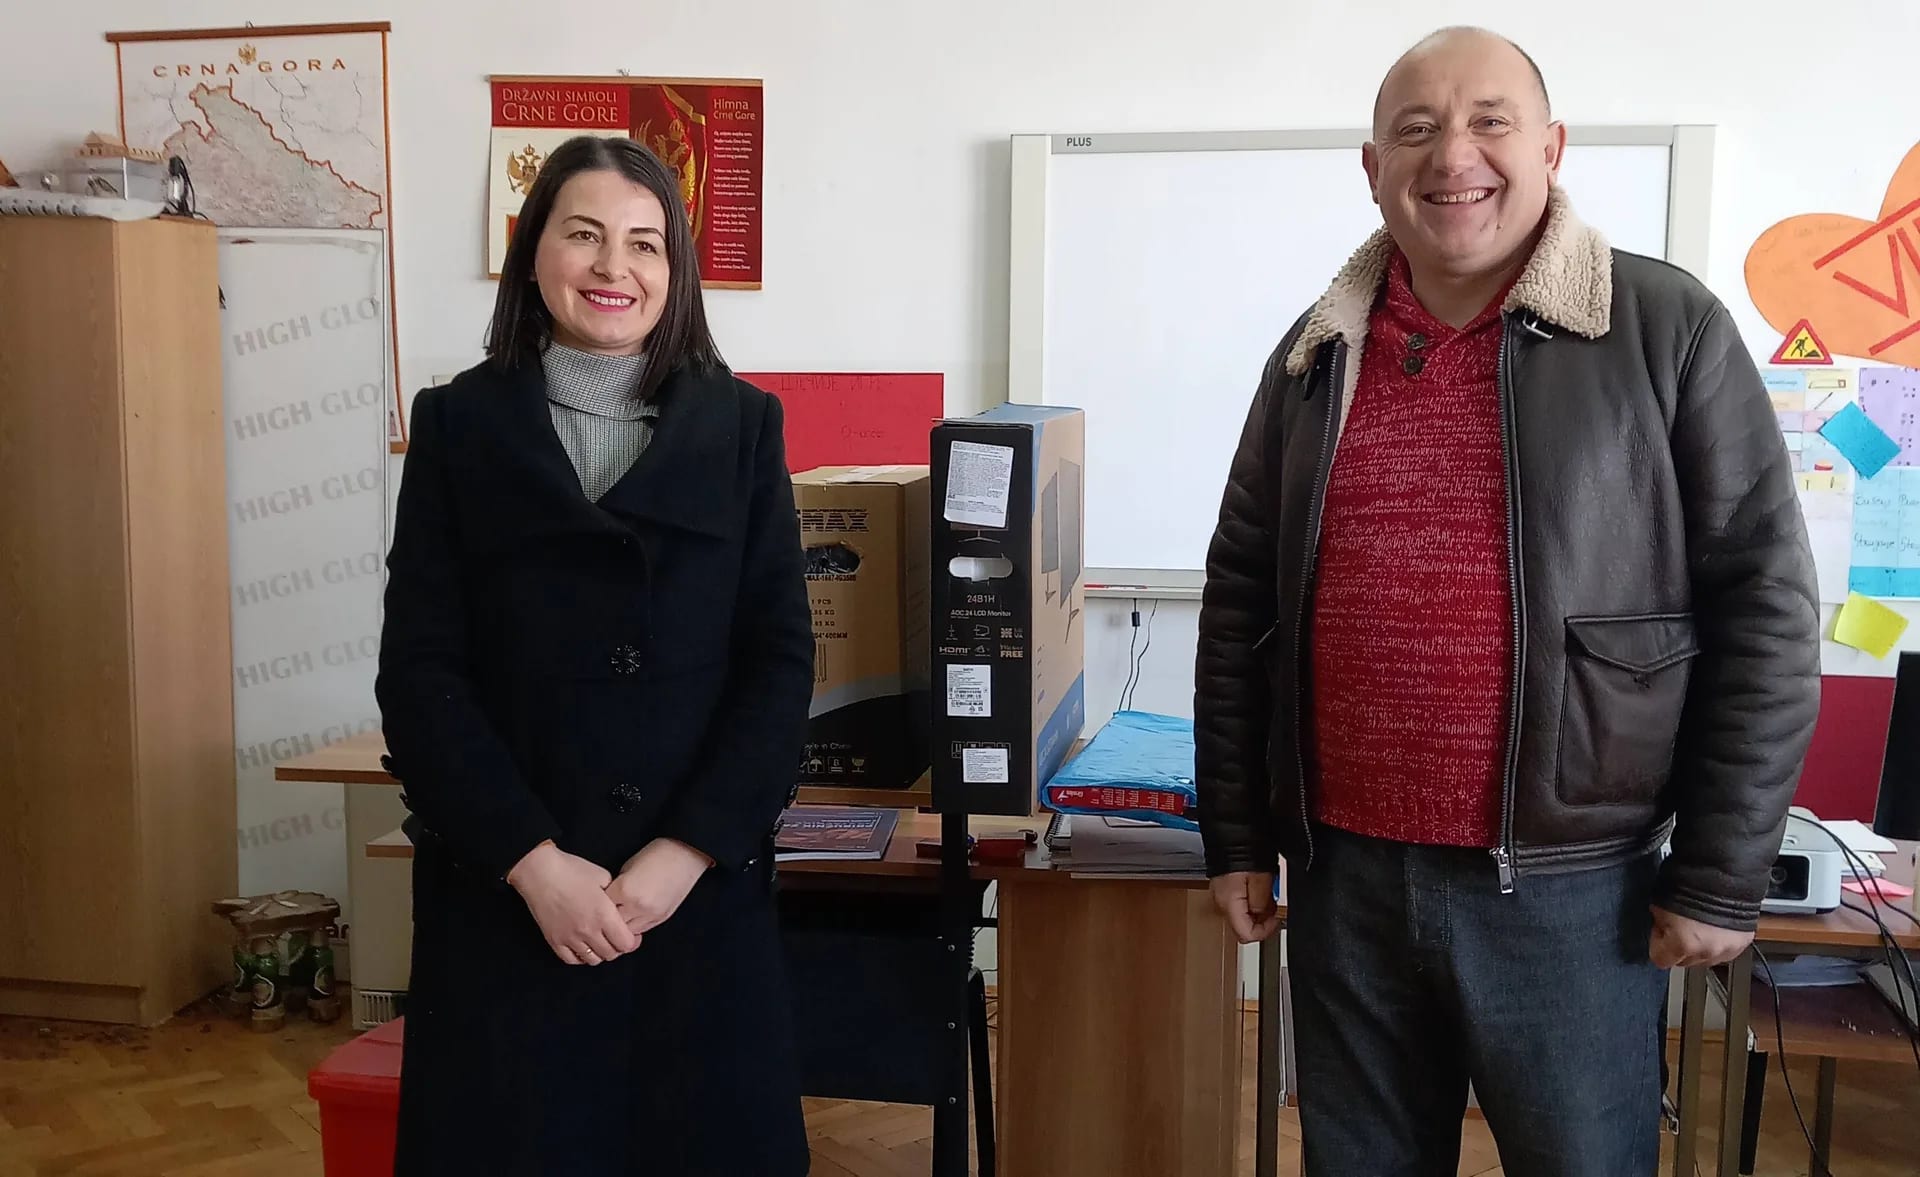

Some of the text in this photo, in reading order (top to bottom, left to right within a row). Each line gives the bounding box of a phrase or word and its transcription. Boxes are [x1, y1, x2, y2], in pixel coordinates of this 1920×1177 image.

[152, 58, 347, 78] CRNA GORA
[713, 98, 749, 110] Himna
[713, 110, 756, 120] Crne Gore
[1066, 137, 1092, 147] PLUS
[232, 315, 312, 356] HIGH
[233, 400, 312, 441] HIGH
[234, 484, 313, 523] HIGH
[236, 567, 315, 606] HIGH
[966, 594, 995, 604] 24B1H
[235, 650, 314, 689] HIGH
[1000, 650, 1024, 658] FREE
[236, 733, 315, 770] HIGH
[238, 813, 313, 849] HIGH
